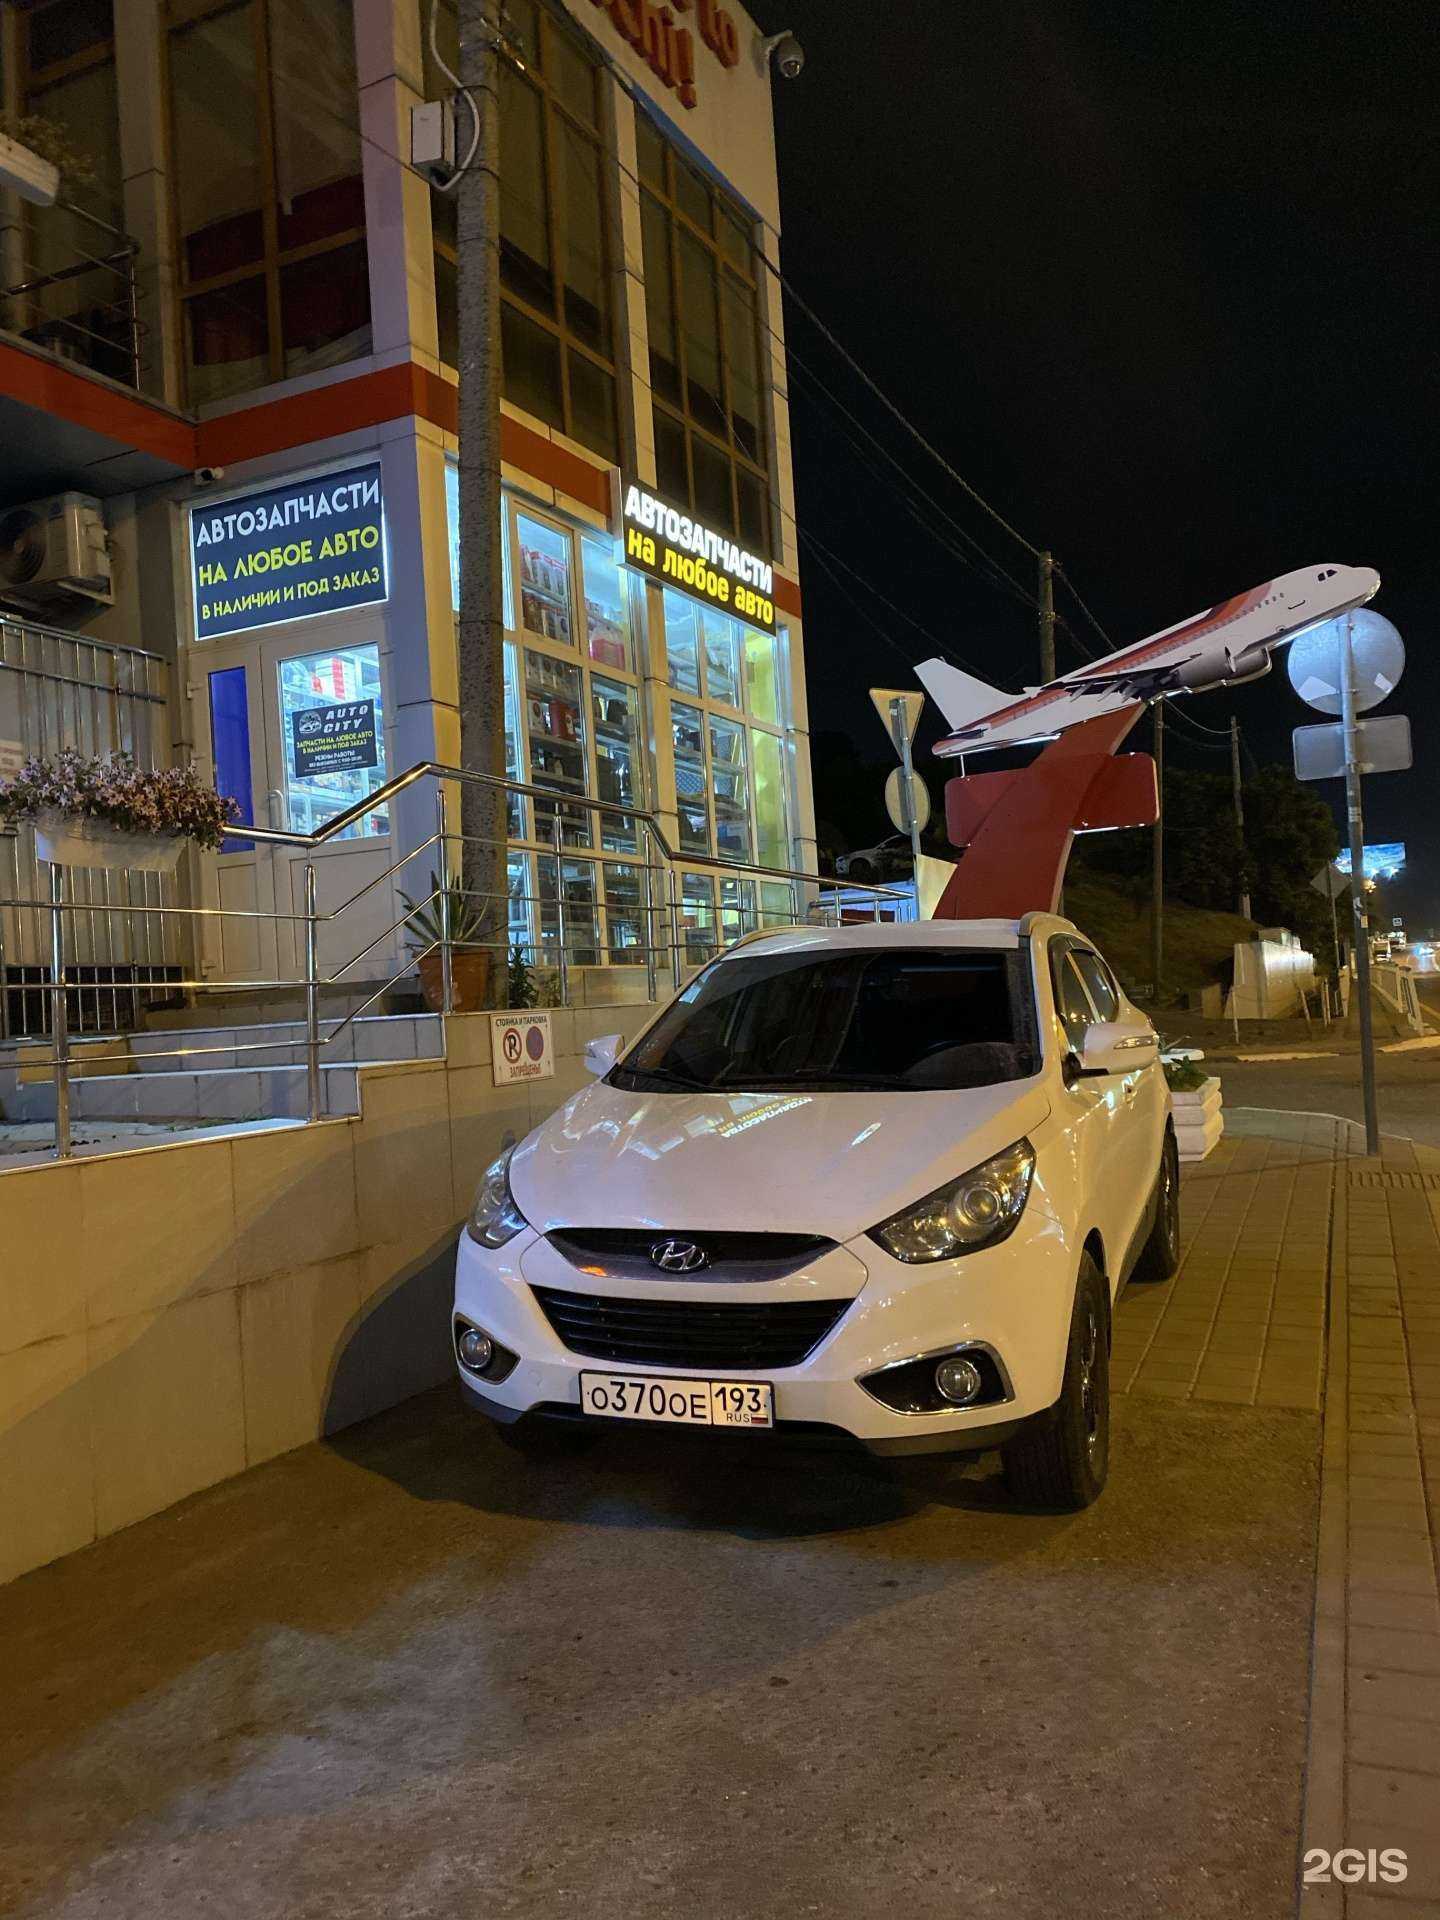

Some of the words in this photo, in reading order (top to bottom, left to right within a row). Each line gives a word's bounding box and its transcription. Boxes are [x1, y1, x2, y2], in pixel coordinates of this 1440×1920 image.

[196, 479, 379, 547] АВТОЗАПЧАСТИ
[199, 562, 227, 587] НА
[233, 540, 313, 579] ЛЮБОЕ
[319, 525, 379, 560] АВТО
[625, 485, 773, 595] АВТОЗАПЧАСТИ
[202, 604, 211, 620] В
[214, 589, 280, 617] НАЛИЧИИ
[284, 586, 294, 602] И
[298, 578, 329, 598] ПОД
[333, 567, 380, 590] ЗАКАЗ
[628, 528, 656, 566] на
[662, 547, 729, 602] любое
[734, 585, 773, 625] авто
[323, 718, 362, 733] CITY
[325, 705, 368, 720] AUTO
[714, 1387, 761, 1412] 193
[726, 1412, 750, 1423] RUS
